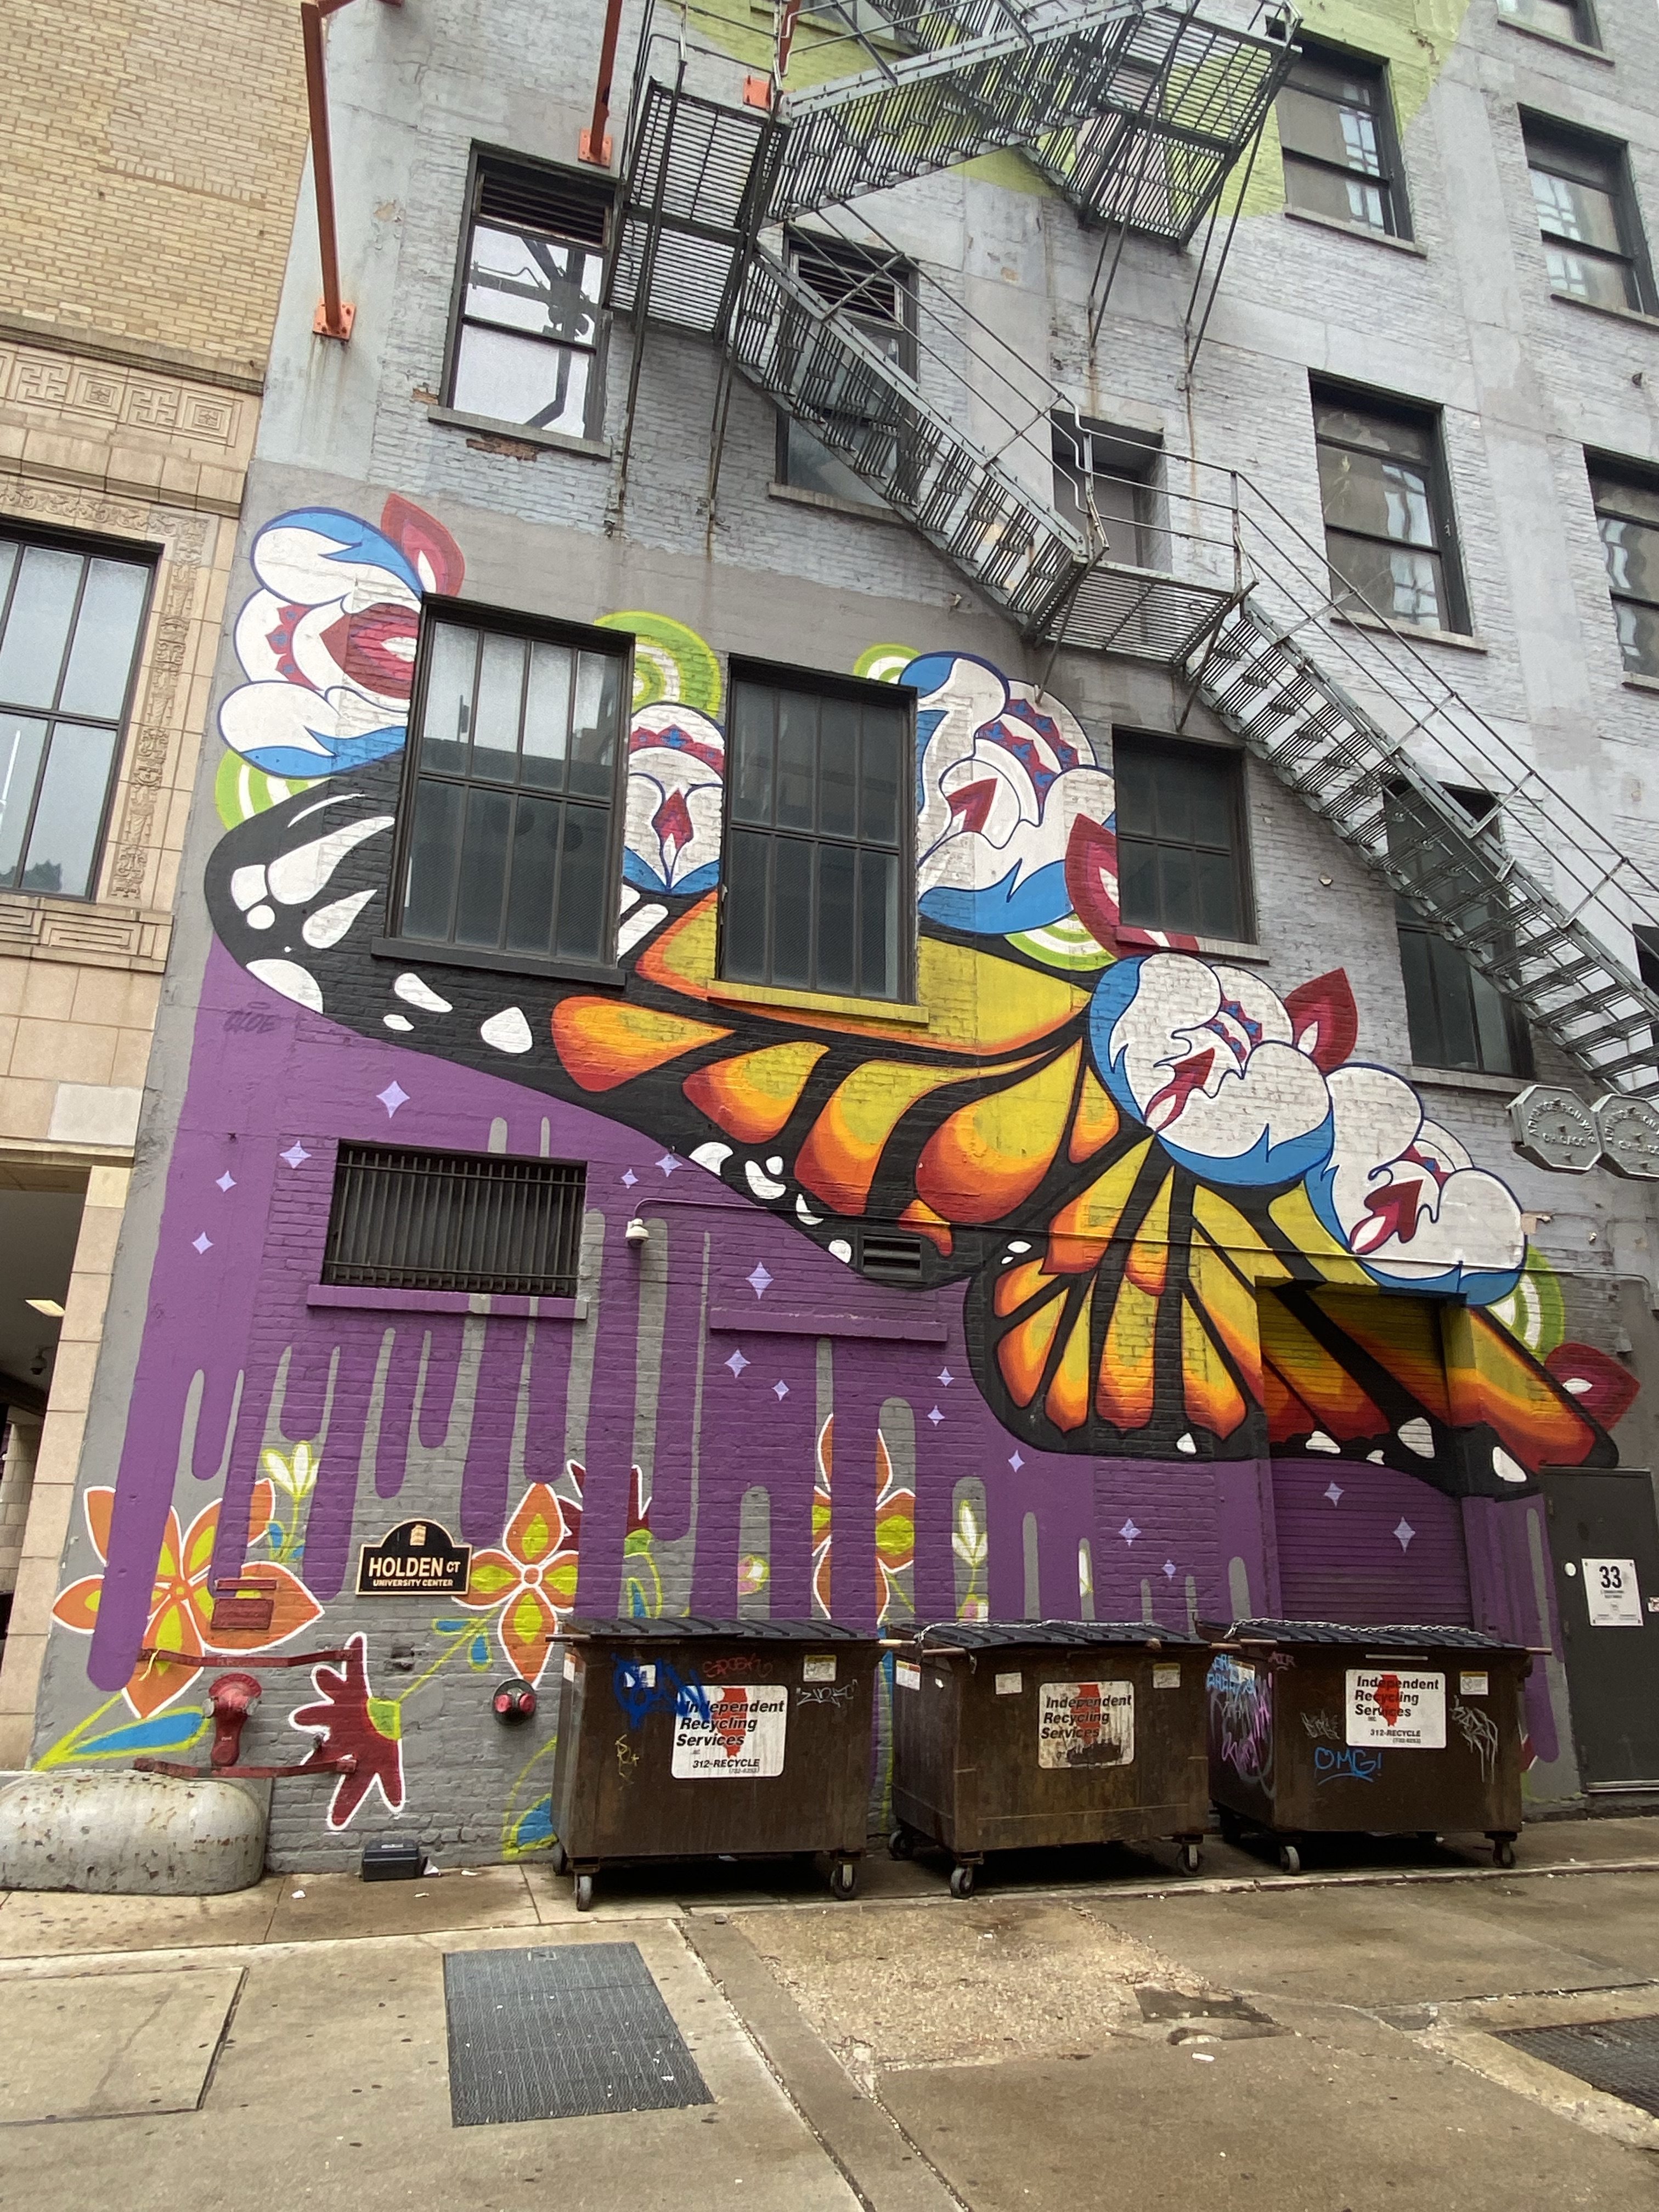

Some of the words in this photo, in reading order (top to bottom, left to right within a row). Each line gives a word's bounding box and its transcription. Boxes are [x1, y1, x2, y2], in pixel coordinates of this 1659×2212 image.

[369, 1557, 444, 1577] HOLDEN
[446, 1561, 461, 1573] CT
[373, 1578, 421, 1587] UNIVERSITY
[422, 1578, 454, 1587] CENTER
[1599, 1566, 1622, 1588] 33
[1357, 1675, 1439, 1691] Independent
[1046, 1695, 1132, 1709] Independent
[1355, 1690, 1419, 1706] Recycling
[685, 1700, 785, 1714] Inependent
[1355, 1703, 1412, 1717] Services
[680, 1717, 758, 1733] Recycling
[1043, 1712, 1110, 1725] Recycling
[1041, 1726, 1100, 1739] Services
[1369, 1729, 1421, 1737] 312-RECYCLE
[676, 1734, 745, 1747] Services
[692, 1758, 760, 1768] 312-RECYCLE
